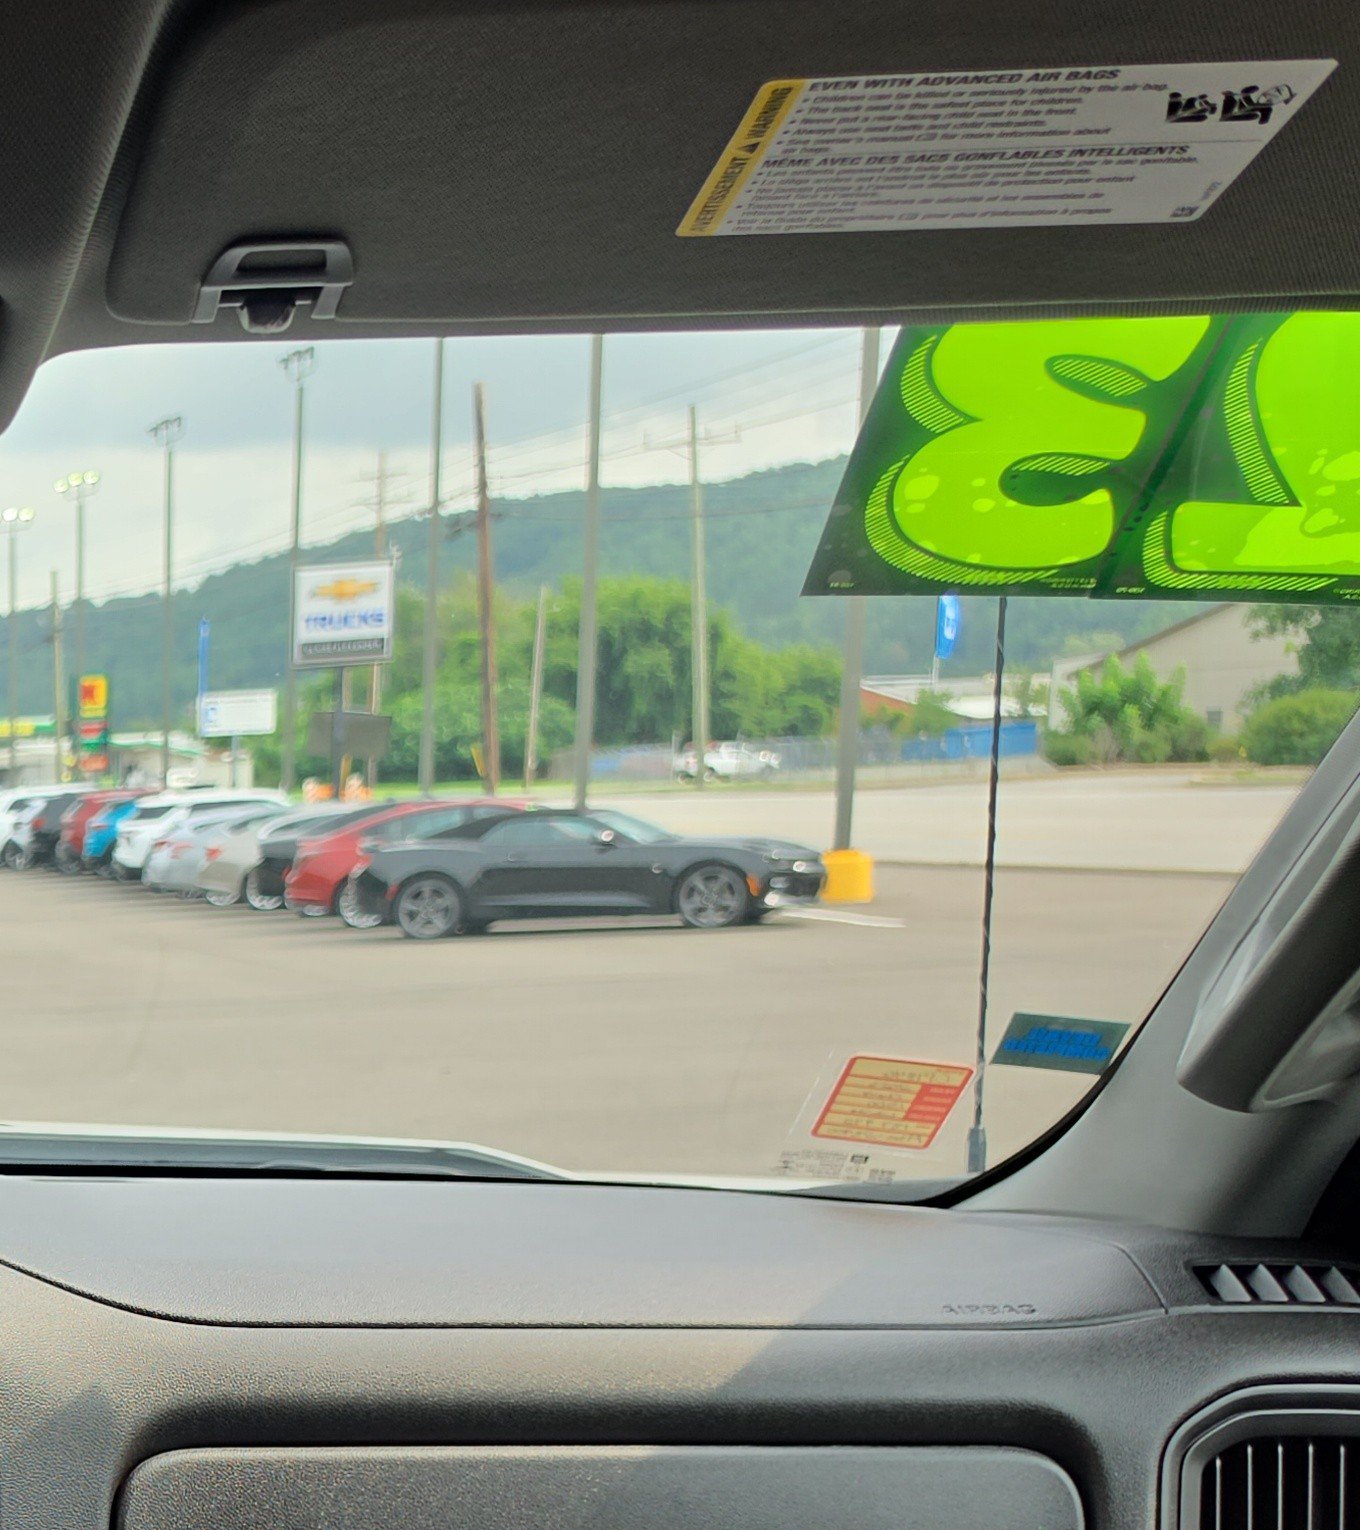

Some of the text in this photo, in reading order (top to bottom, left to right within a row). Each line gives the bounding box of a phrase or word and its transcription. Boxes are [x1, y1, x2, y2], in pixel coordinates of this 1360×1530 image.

[807, 69, 1123, 91] EVEN WITH ADVANCED AIR BAGS
[745, 86, 794, 140] WARNING
[688, 155, 750, 232] AVERTISSEMENT
[305, 609, 384, 631] TRUCKS
